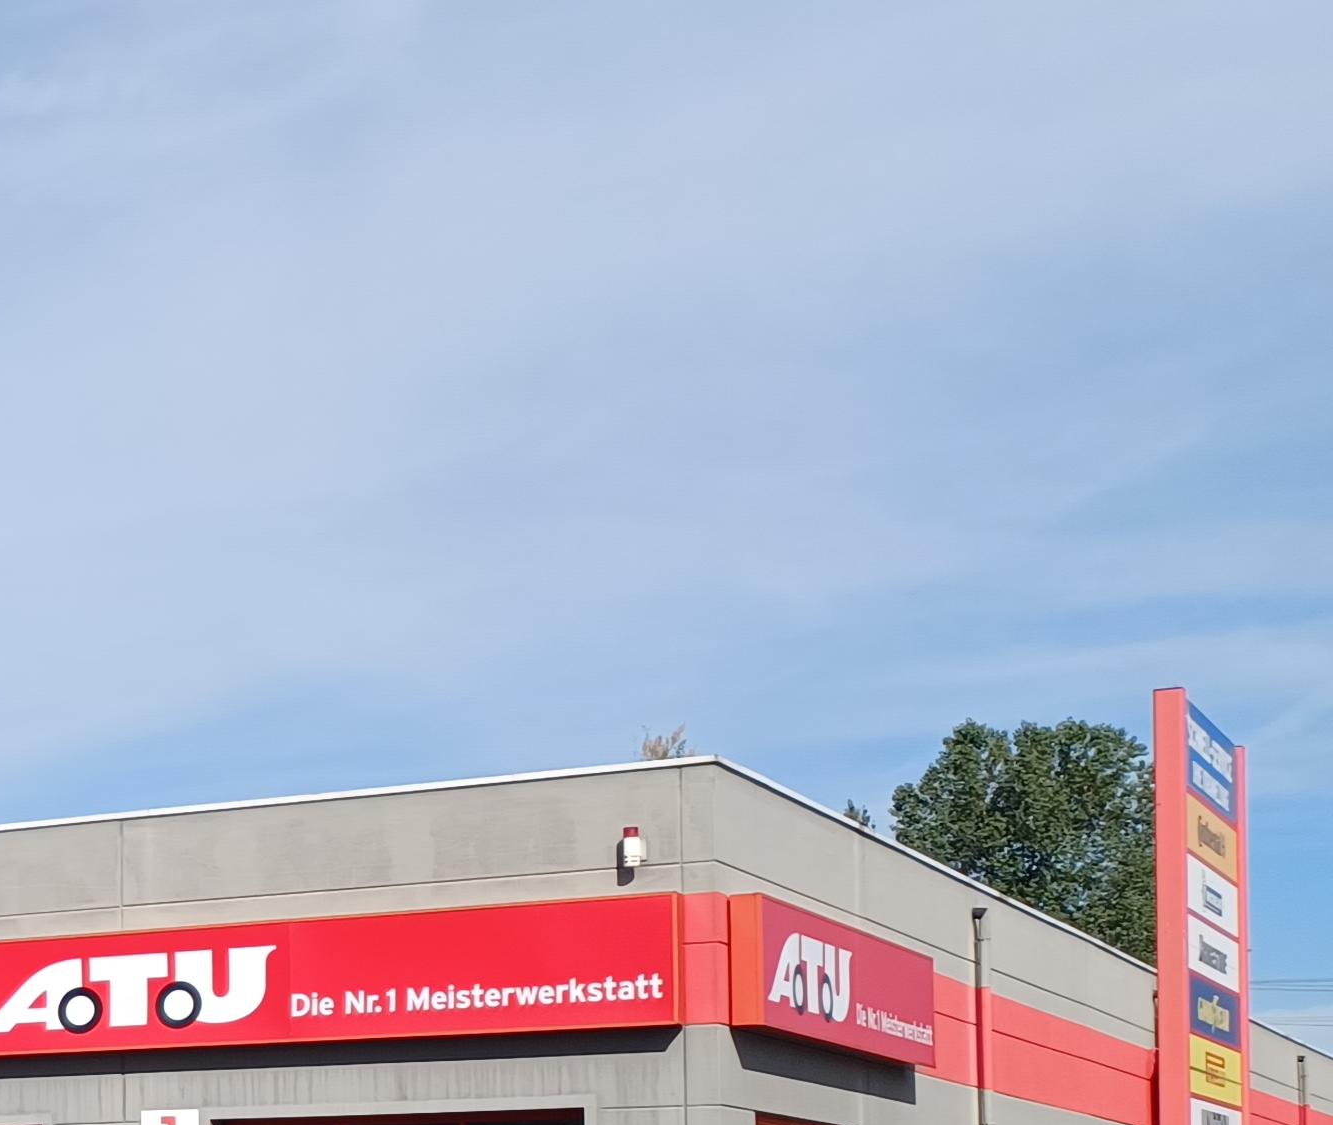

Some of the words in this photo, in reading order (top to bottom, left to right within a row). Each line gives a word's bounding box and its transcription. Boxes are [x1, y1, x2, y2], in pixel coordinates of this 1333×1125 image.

[290, 992, 334, 1018] Die
[406, 972, 664, 1012] Meisterwerkstatt
[768, 932, 852, 1023] ATU
